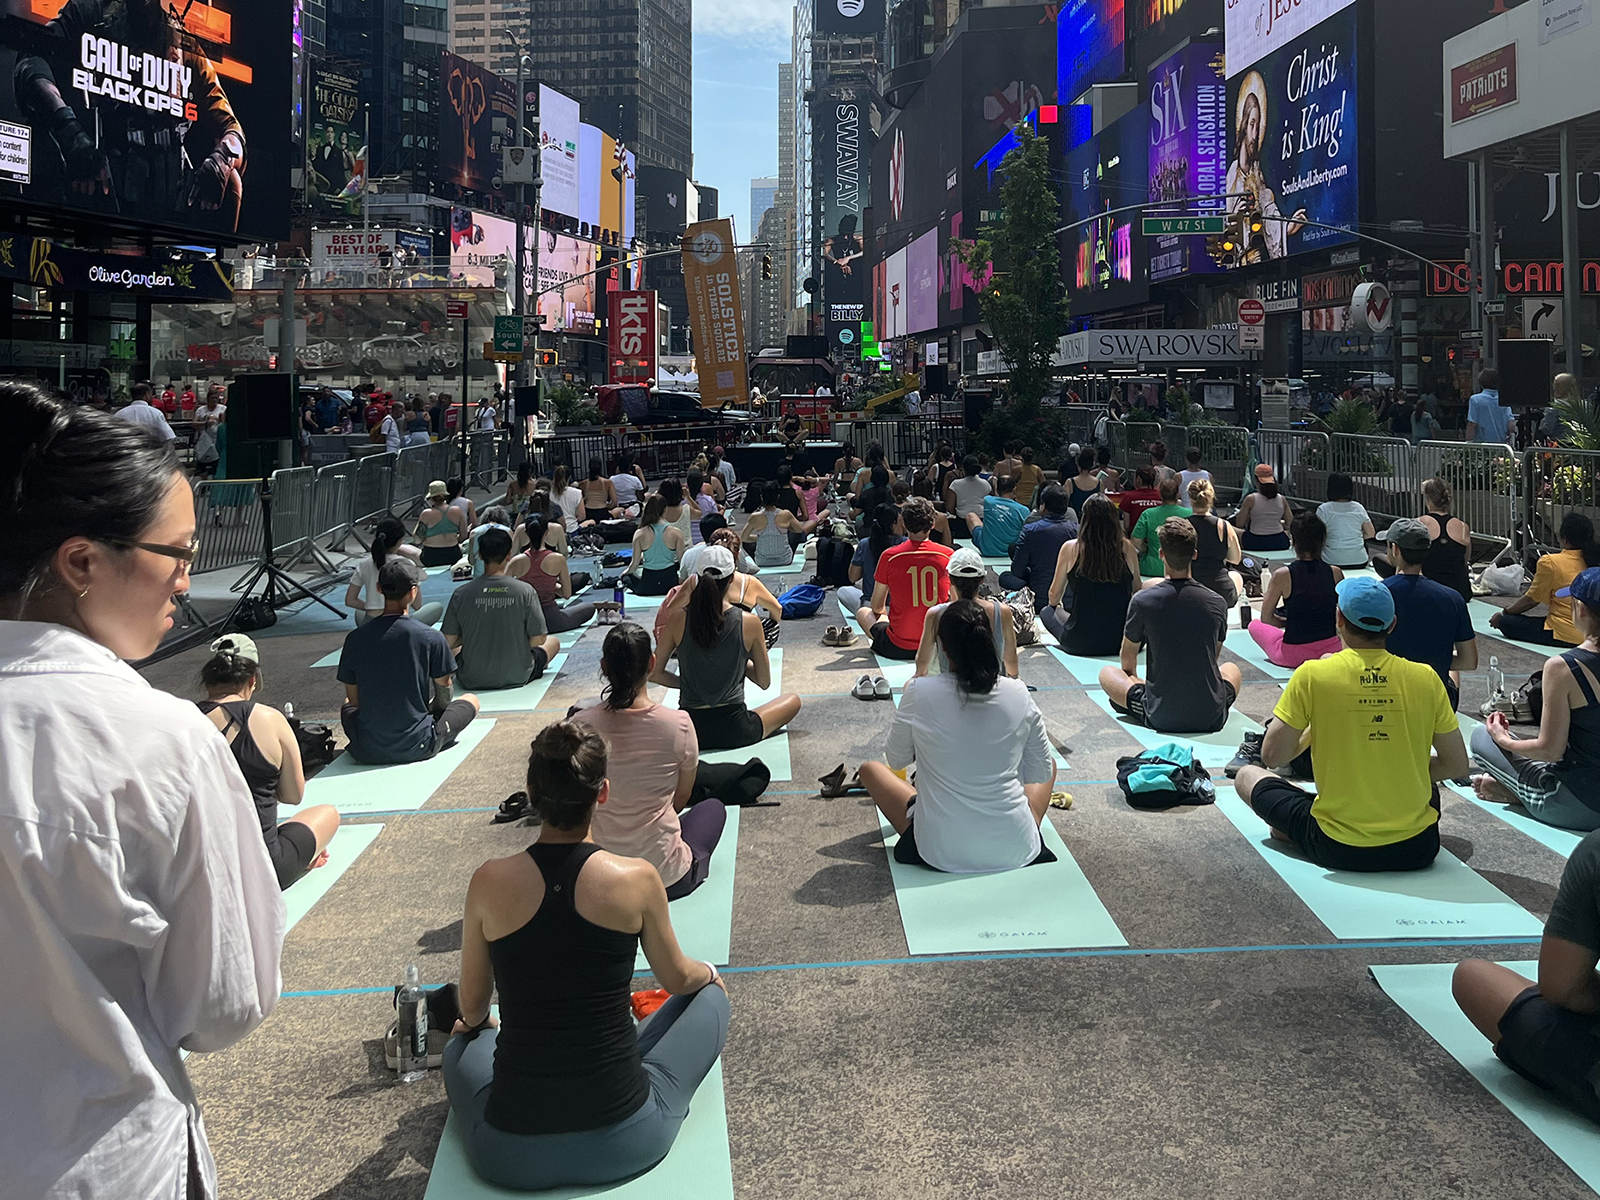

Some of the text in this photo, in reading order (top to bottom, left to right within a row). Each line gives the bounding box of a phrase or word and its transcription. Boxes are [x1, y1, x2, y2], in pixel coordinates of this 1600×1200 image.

[1266, 0, 1301, 36] JES
[81, 32, 132, 82] CALL
[129, 54, 142, 72] OF
[1286, 45, 1340, 103] Christ
[72, 67, 199, 121] BLACK OPS 6
[315, 85, 331, 104] THE
[320, 102, 356, 122] GATSBY
[526, 104, 536, 112] LG
[1281, 89, 1347, 161] is King!
[1197, 85, 1216, 207] GLOBAL SENSATION
[835, 104, 859, 212] SWAVAY
[1281, 164, 1347, 196] SoulsAndLiberty.com
[1541, 172, 1600, 222] JU
[1161, 219, 1206, 231] W 47 St
[326, 245, 350, 255] THE
[332, 234, 382, 245] BEST OF
[468, 252, 478, 266] 8.3
[88, 265, 175, 288] Olive Garden
[538, 266, 558, 280] FRIENDS
[558, 270, 569, 281] LIVE
[1504, 262, 1600, 293] CAMN
[693, 276, 702, 296] Mind
[1256, 278, 1298, 301] BLUE FIN
[1303, 278, 1320, 301] DOS
[620, 295, 649, 356] tkts
[706, 274, 726, 364] in TIMES SQUARE
[716, 272, 740, 363] SOLSTICE
[830, 309, 864, 321] BILLY
[699, 315, 708, 346] Madness
[187, 342, 221, 361] tkts
[703, 347, 711, 365] Yoga
[1099, 334, 1244, 356] SWAROVSK
[905, 565, 939, 607] 10
